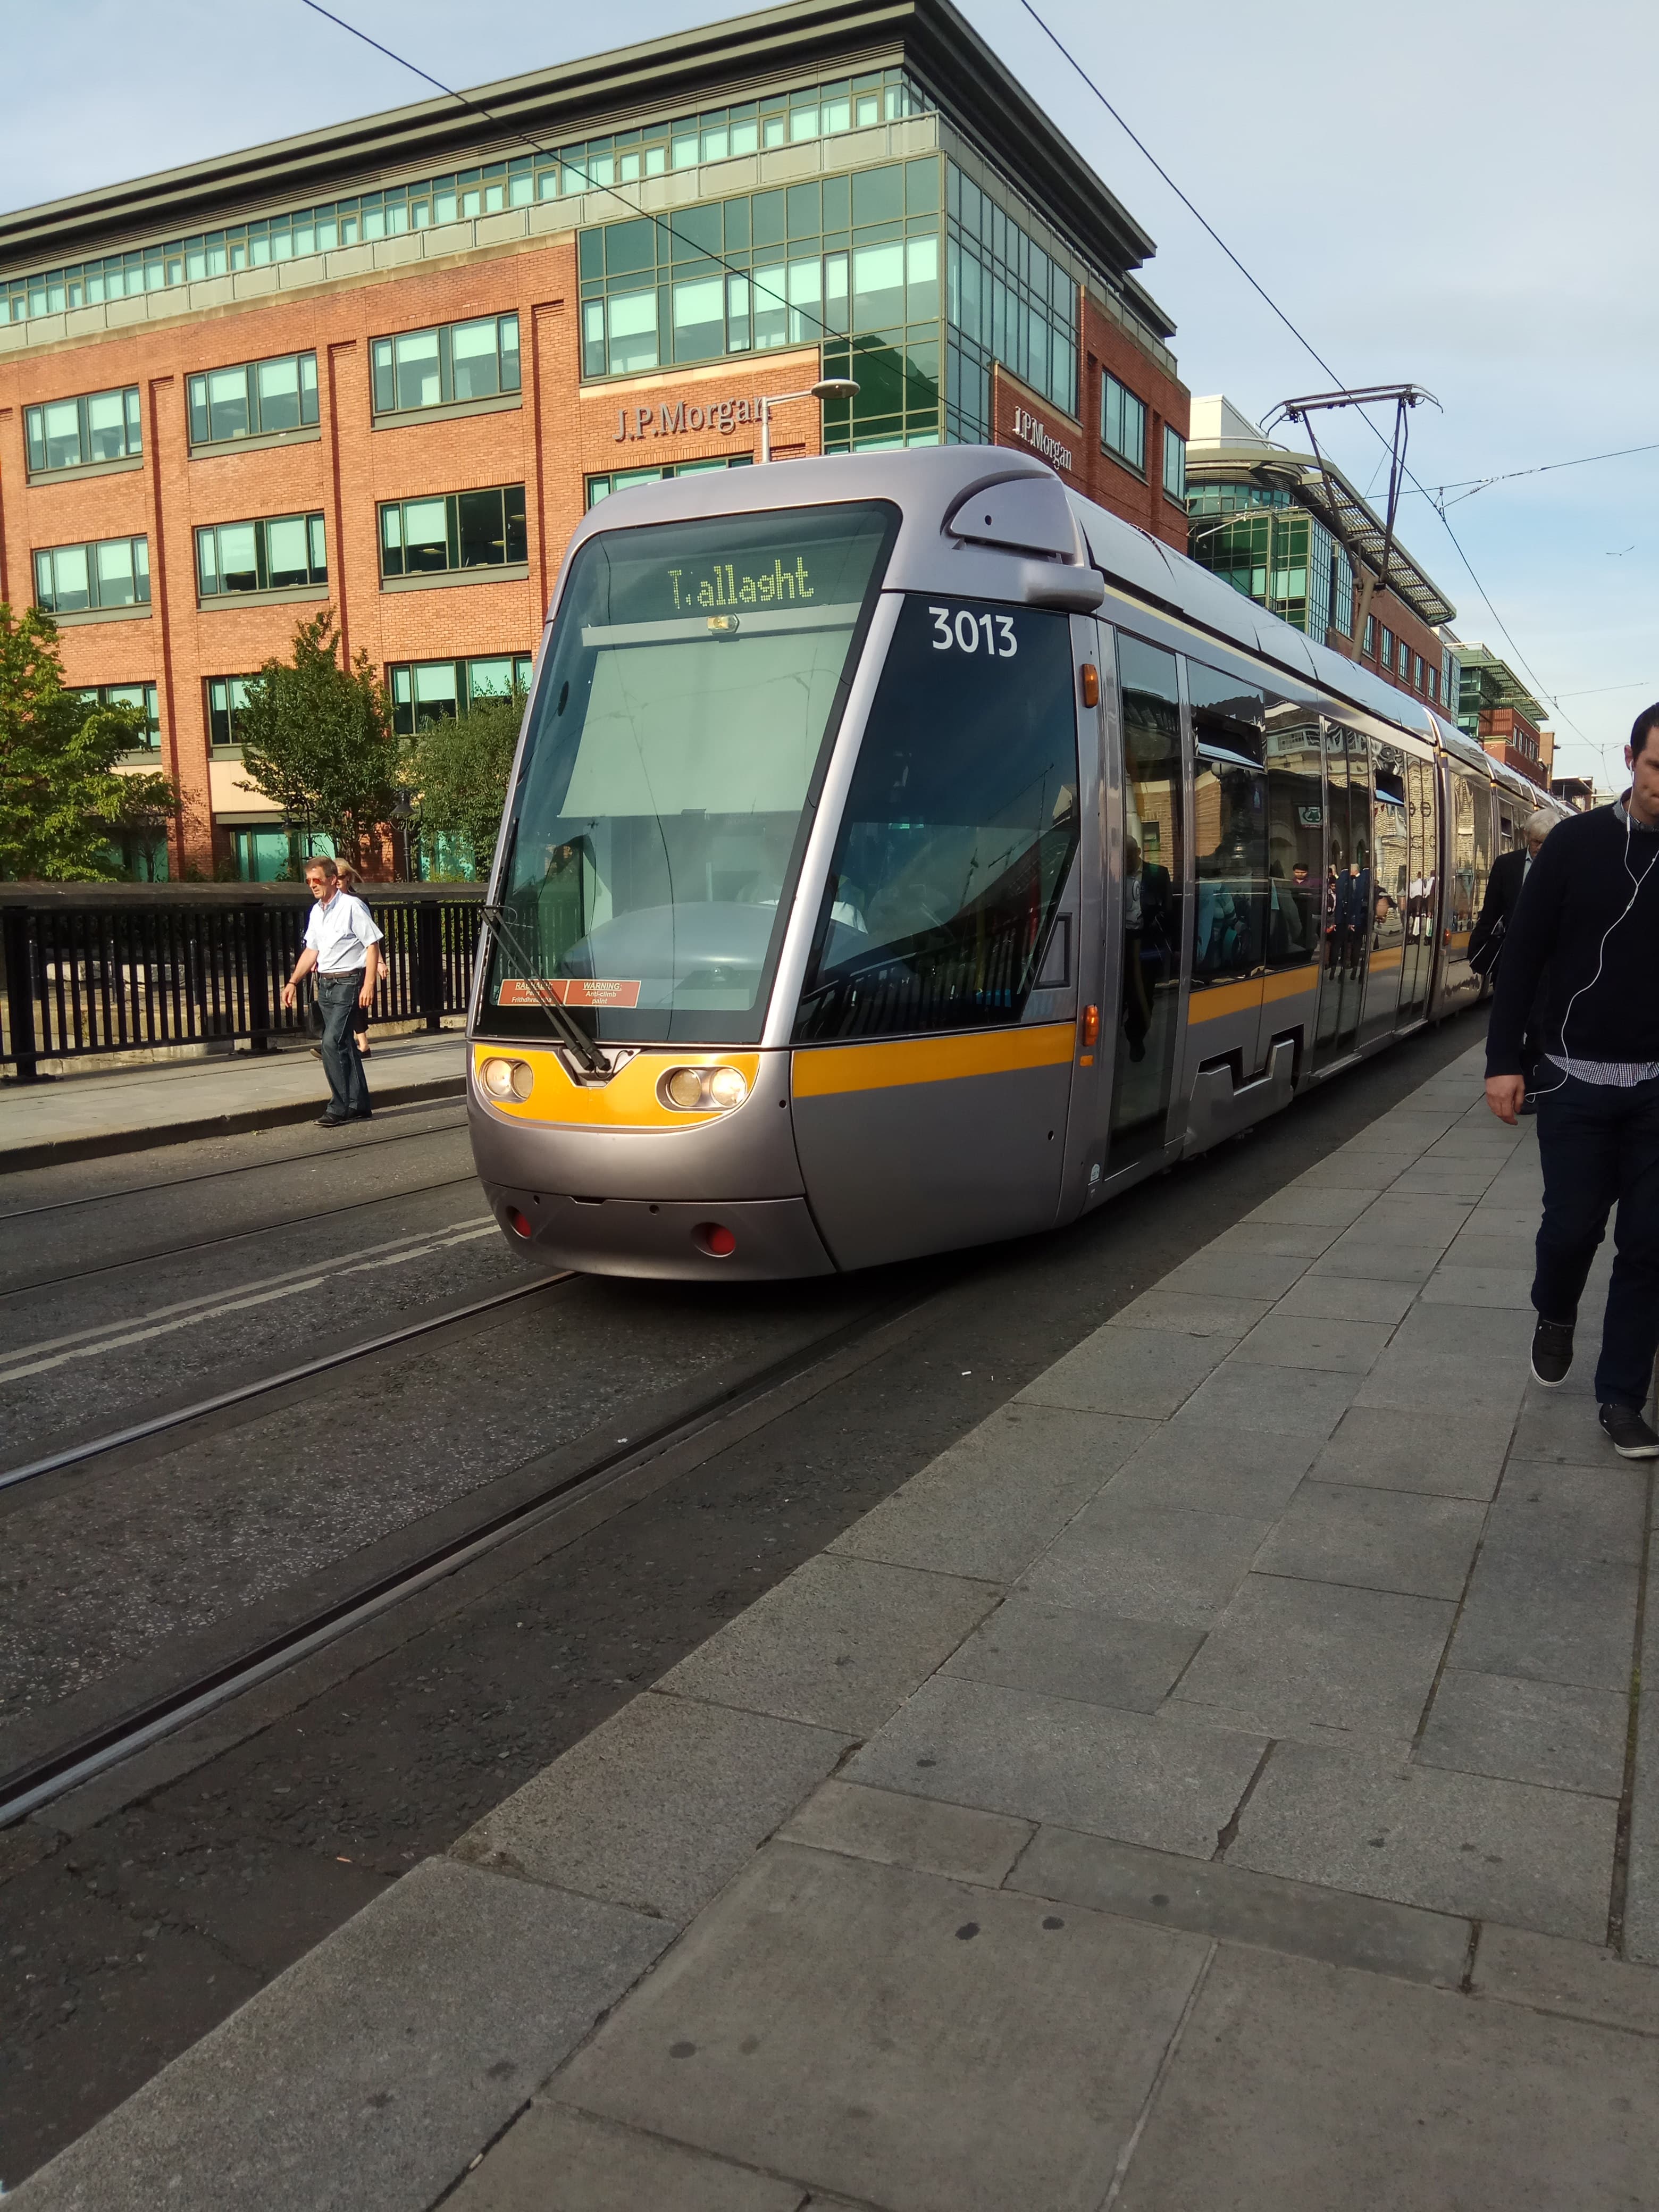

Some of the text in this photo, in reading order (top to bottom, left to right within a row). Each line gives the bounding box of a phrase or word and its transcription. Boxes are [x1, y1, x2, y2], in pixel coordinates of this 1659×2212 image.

[612, 397, 772, 441] J.P.Morgan
[929, 607, 1017, 657] 3013
[583, 982, 622, 991] WARNING:
